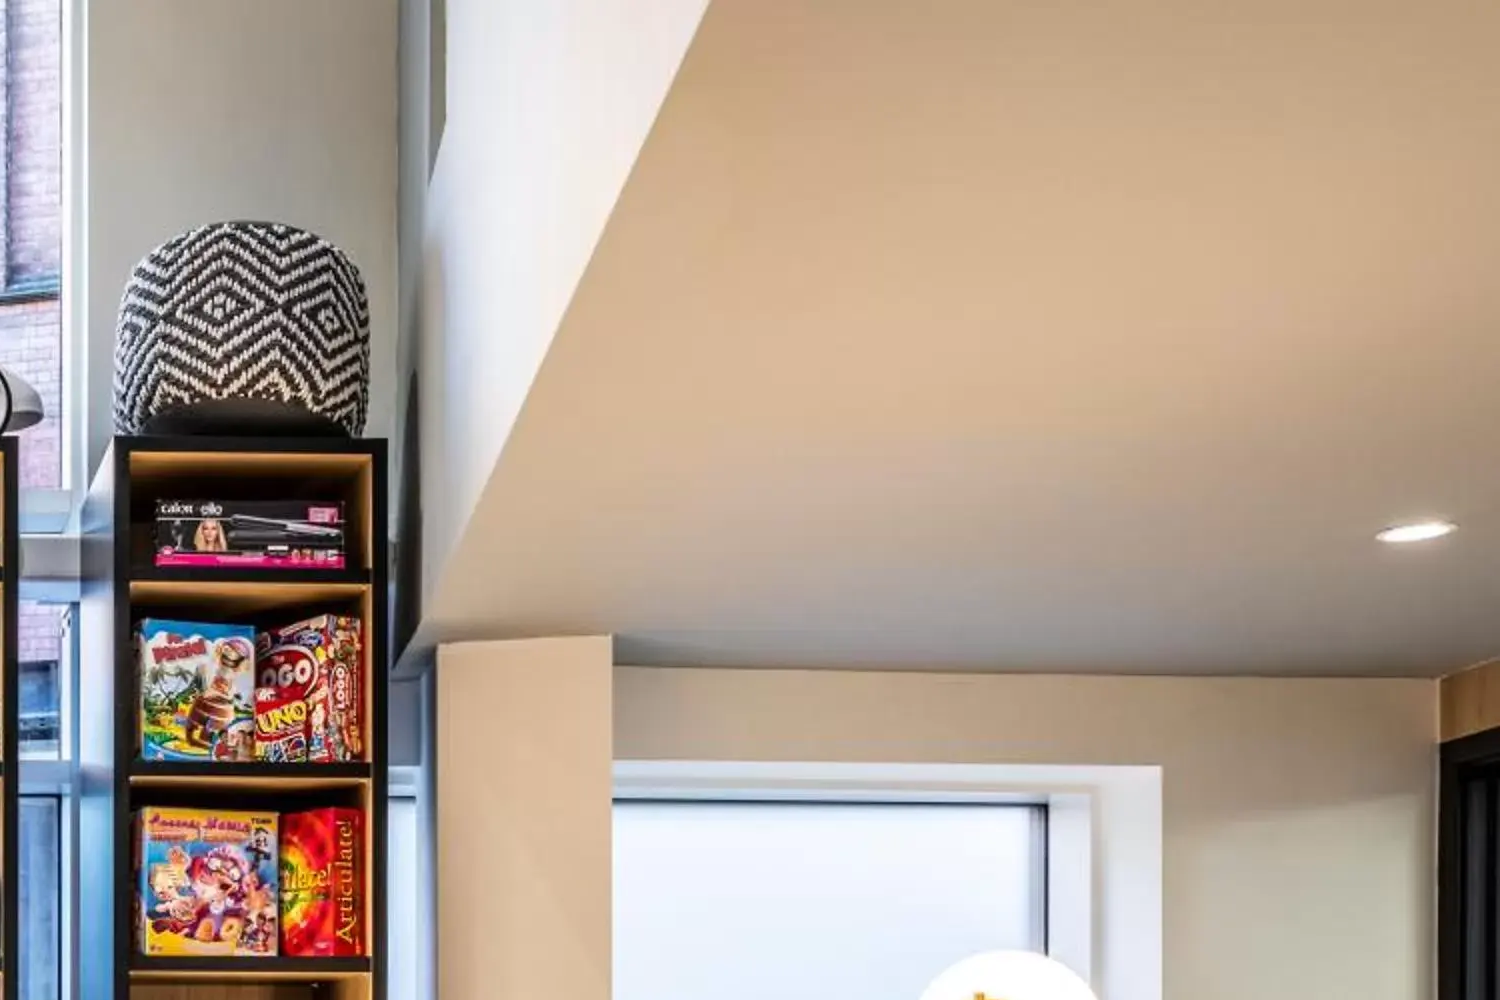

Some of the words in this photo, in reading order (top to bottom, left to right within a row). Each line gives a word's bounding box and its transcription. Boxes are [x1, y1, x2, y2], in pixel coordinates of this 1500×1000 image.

[261, 658, 312, 689] OGO
[257, 700, 307, 733] UNO
[335, 820, 357, 945] Articulate!
